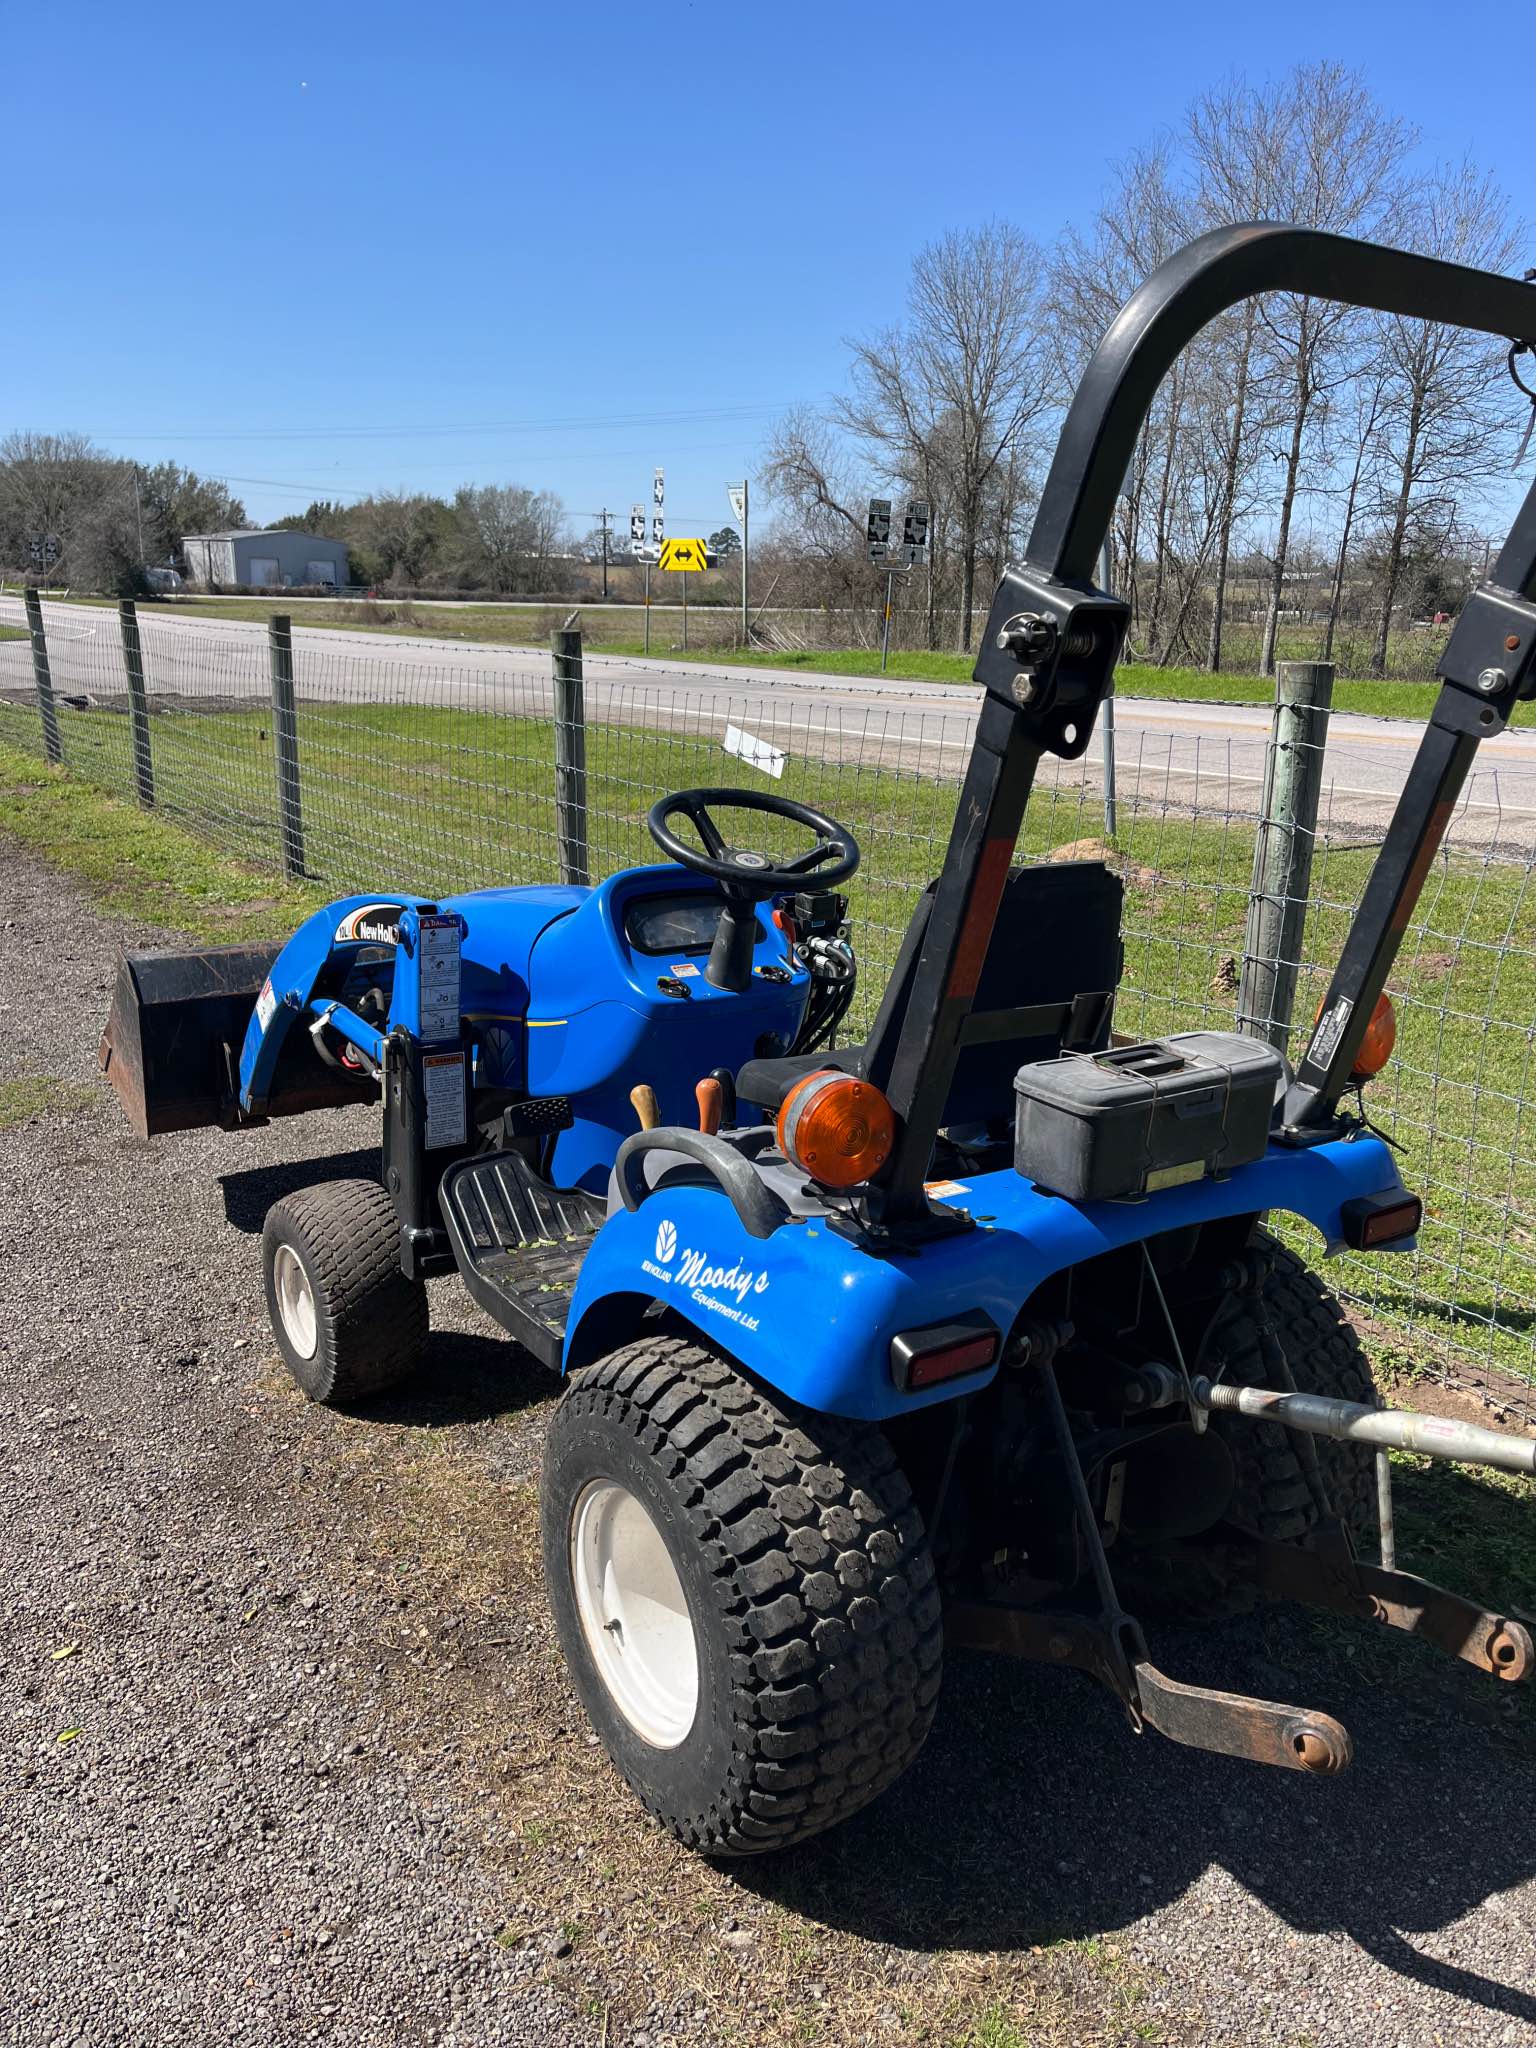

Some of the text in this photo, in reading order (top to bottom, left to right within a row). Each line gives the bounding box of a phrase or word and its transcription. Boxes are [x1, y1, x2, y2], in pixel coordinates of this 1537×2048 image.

[909, 504, 926, 515] WEST
[691, 1288, 761, 1331] Equipment Ltd.
